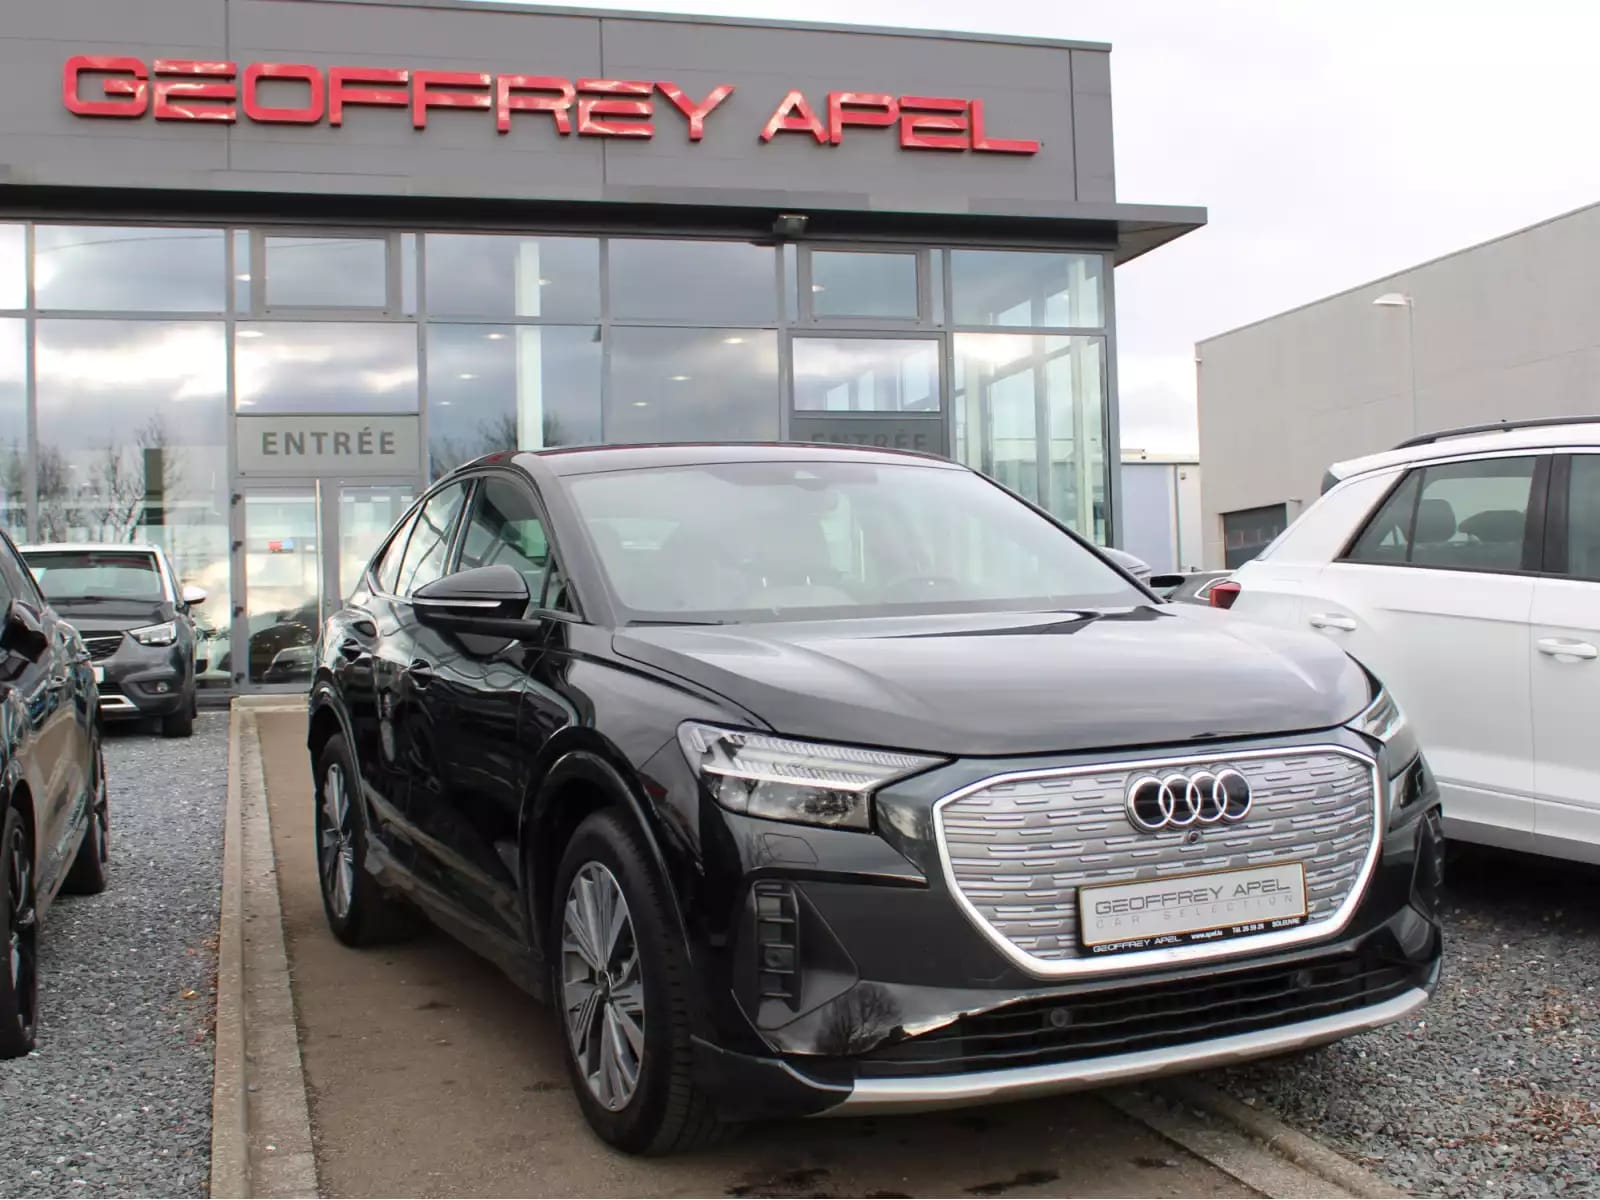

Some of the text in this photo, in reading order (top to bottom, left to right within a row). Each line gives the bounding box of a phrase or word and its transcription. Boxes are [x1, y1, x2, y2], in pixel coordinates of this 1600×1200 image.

[63, 55, 1039, 155] GEOFFREY APEL
[262, 426, 395, 455] ENTRÉE
[1095, 879, 1291, 914] GEOFFREY APEL
[1096, 915, 1140, 928] CAR
[1093, 939, 1151, 953] GEOFFREY
[1154, 935, 1182, 945] APEL
